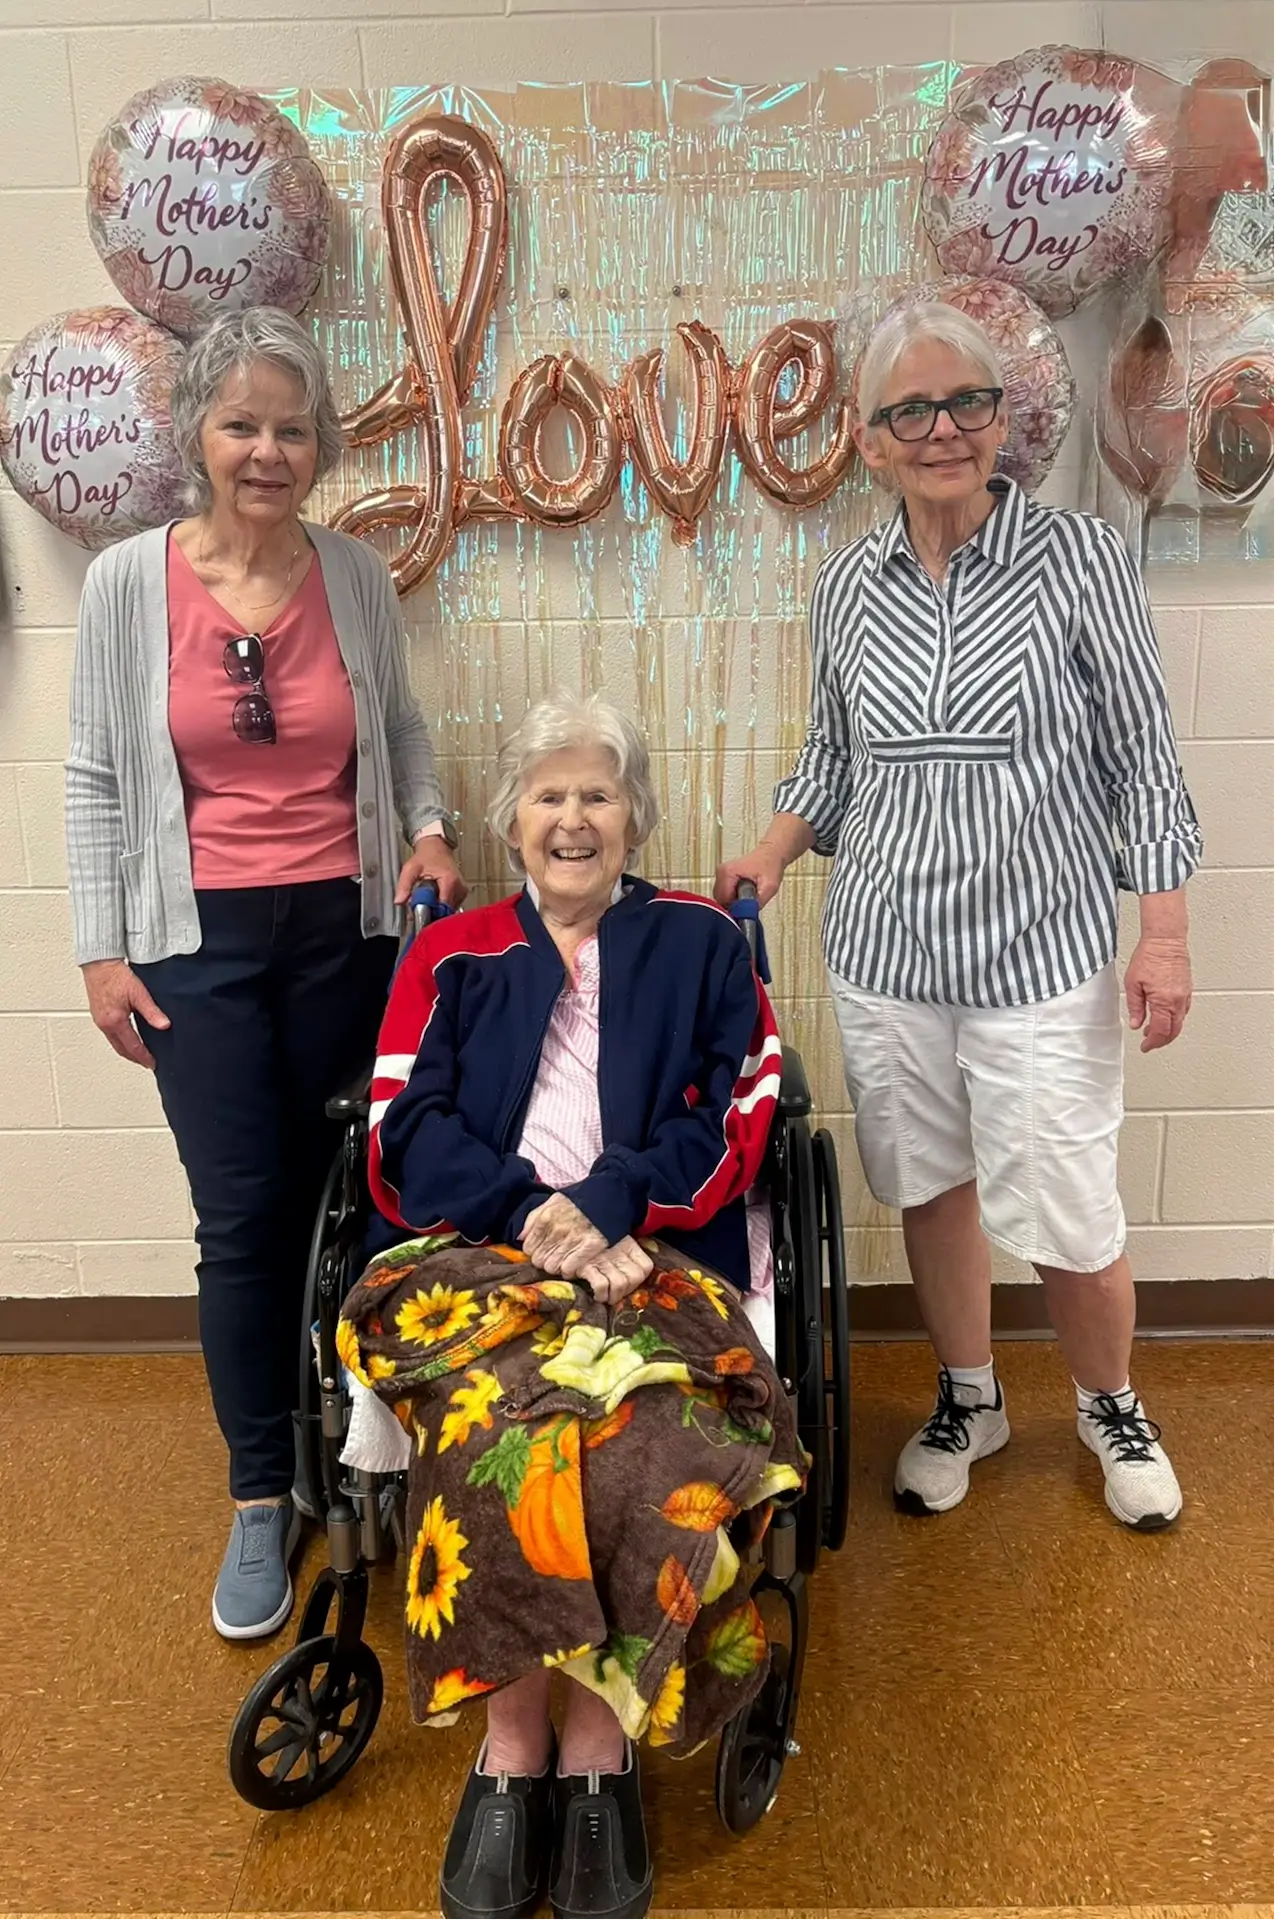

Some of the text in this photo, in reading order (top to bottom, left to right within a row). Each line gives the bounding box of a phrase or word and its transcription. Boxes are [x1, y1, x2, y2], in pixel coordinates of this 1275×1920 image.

[988, 81, 1123, 141] Happy
[129, 113, 268, 175] Happy
[105, 174, 272, 236] Mother's
[960, 145, 1127, 210] Mother's
[139, 245, 253, 300] Day
[980, 217, 1098, 270] Day
[12, 346, 125, 402] Happy
[328, 112, 858, 597] Love
[1, 408, 141, 465] Mother's
[33, 470, 133, 516] Day
